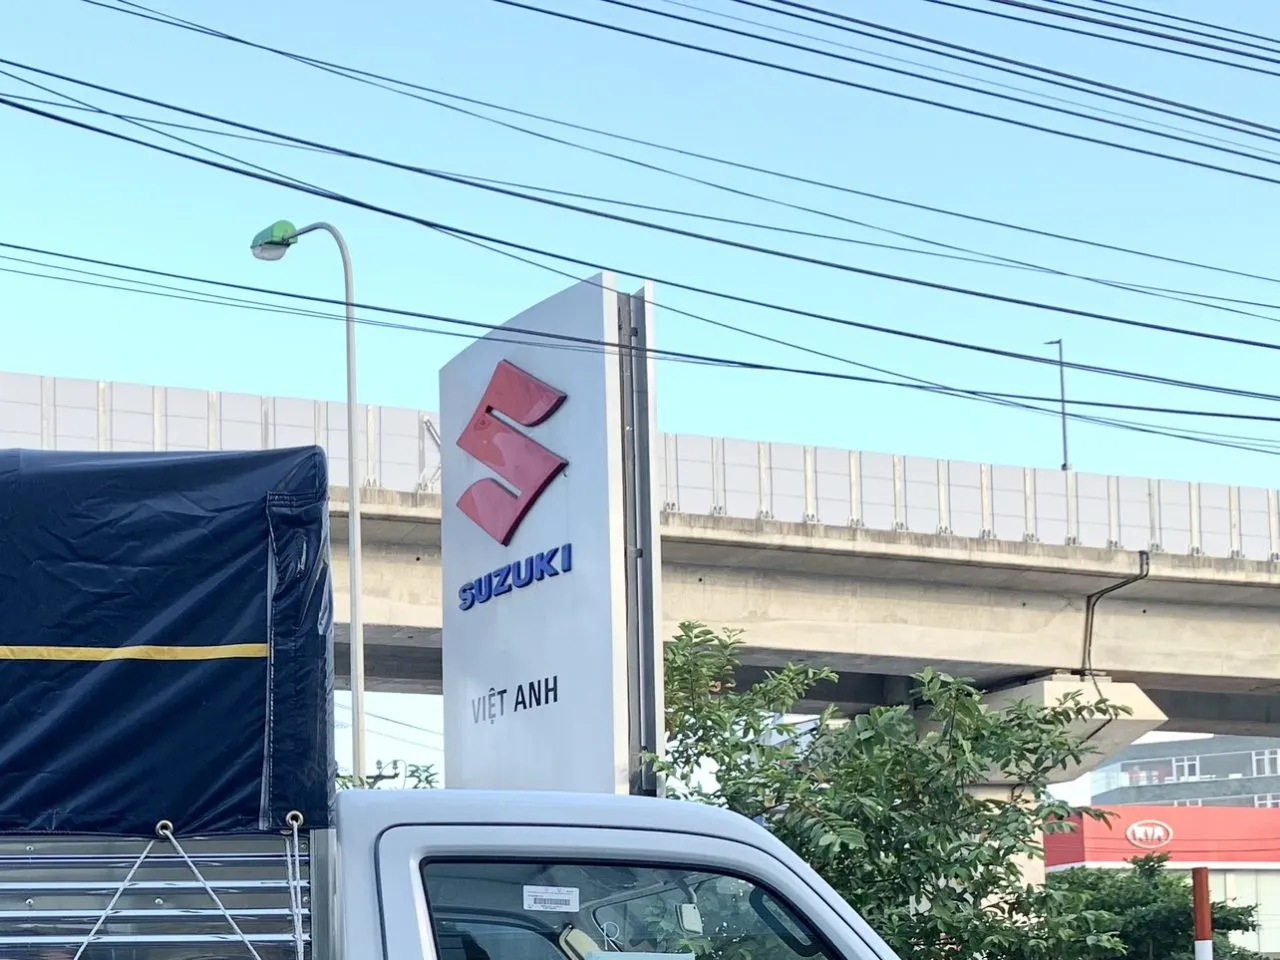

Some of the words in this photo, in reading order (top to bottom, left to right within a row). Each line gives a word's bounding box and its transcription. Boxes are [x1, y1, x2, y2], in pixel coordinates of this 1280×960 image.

[458, 543, 572, 611] SUZUKI
[472, 687, 507, 724] VIỆT
[513, 675, 558, 712] ANH
